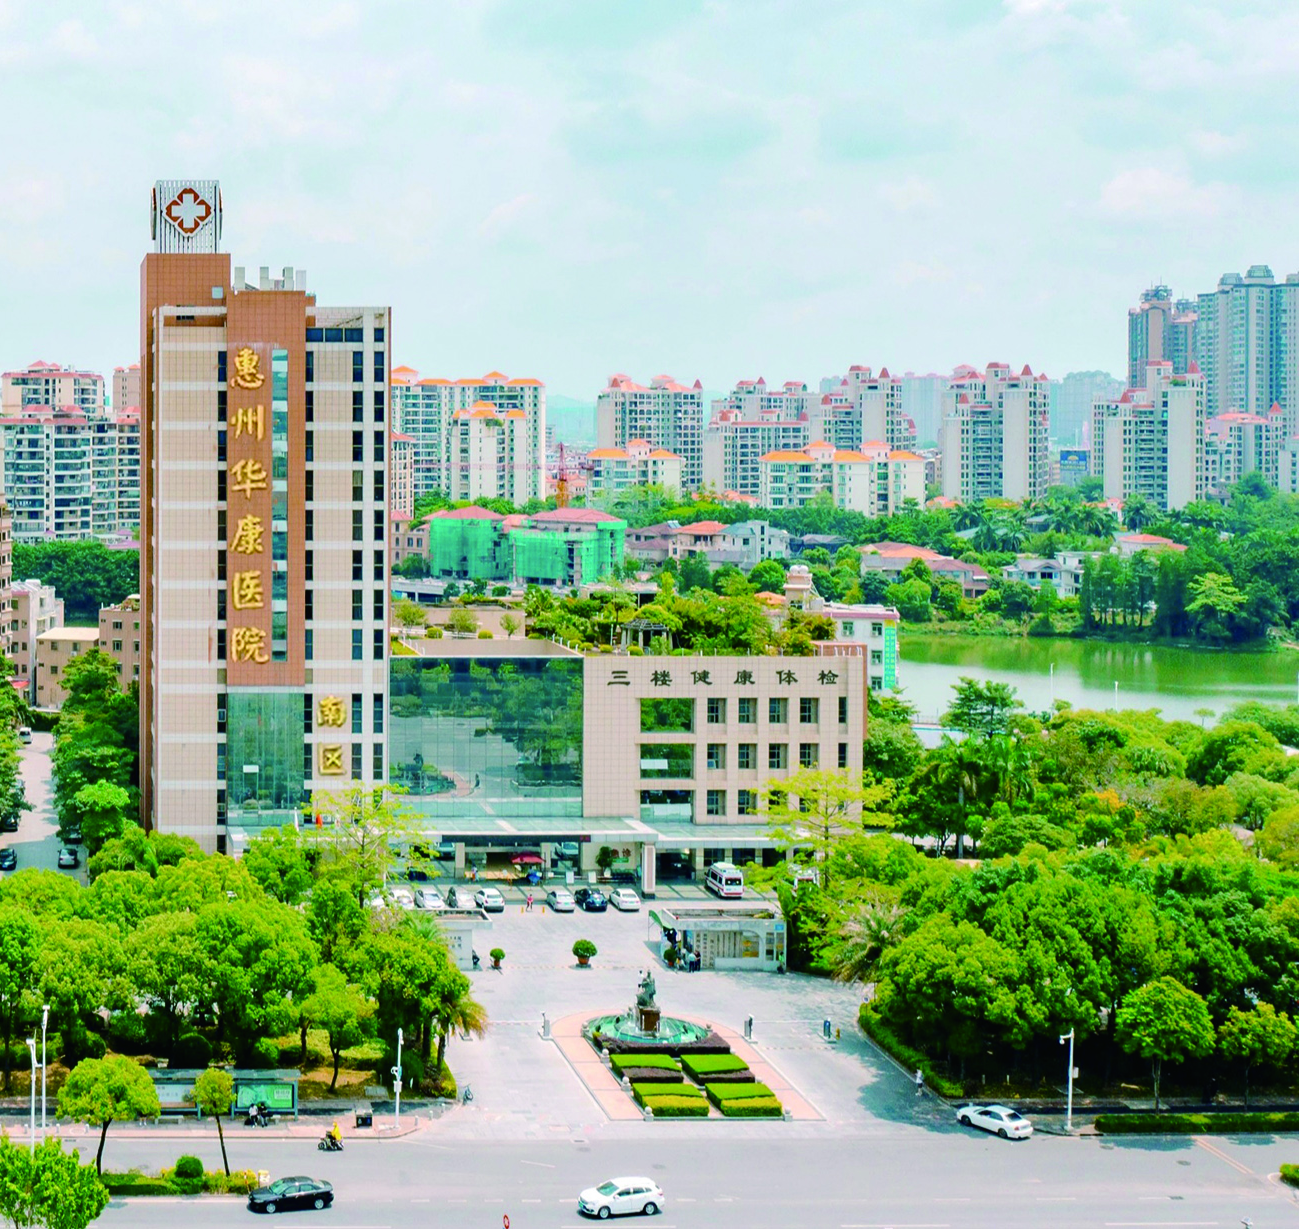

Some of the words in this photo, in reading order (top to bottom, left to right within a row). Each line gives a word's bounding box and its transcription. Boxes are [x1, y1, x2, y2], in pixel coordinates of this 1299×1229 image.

[230, 347, 270, 664] 惠州华康医院
[607, 669, 839, 687] 三楼健康体检
[316, 694, 348, 776] 南区
